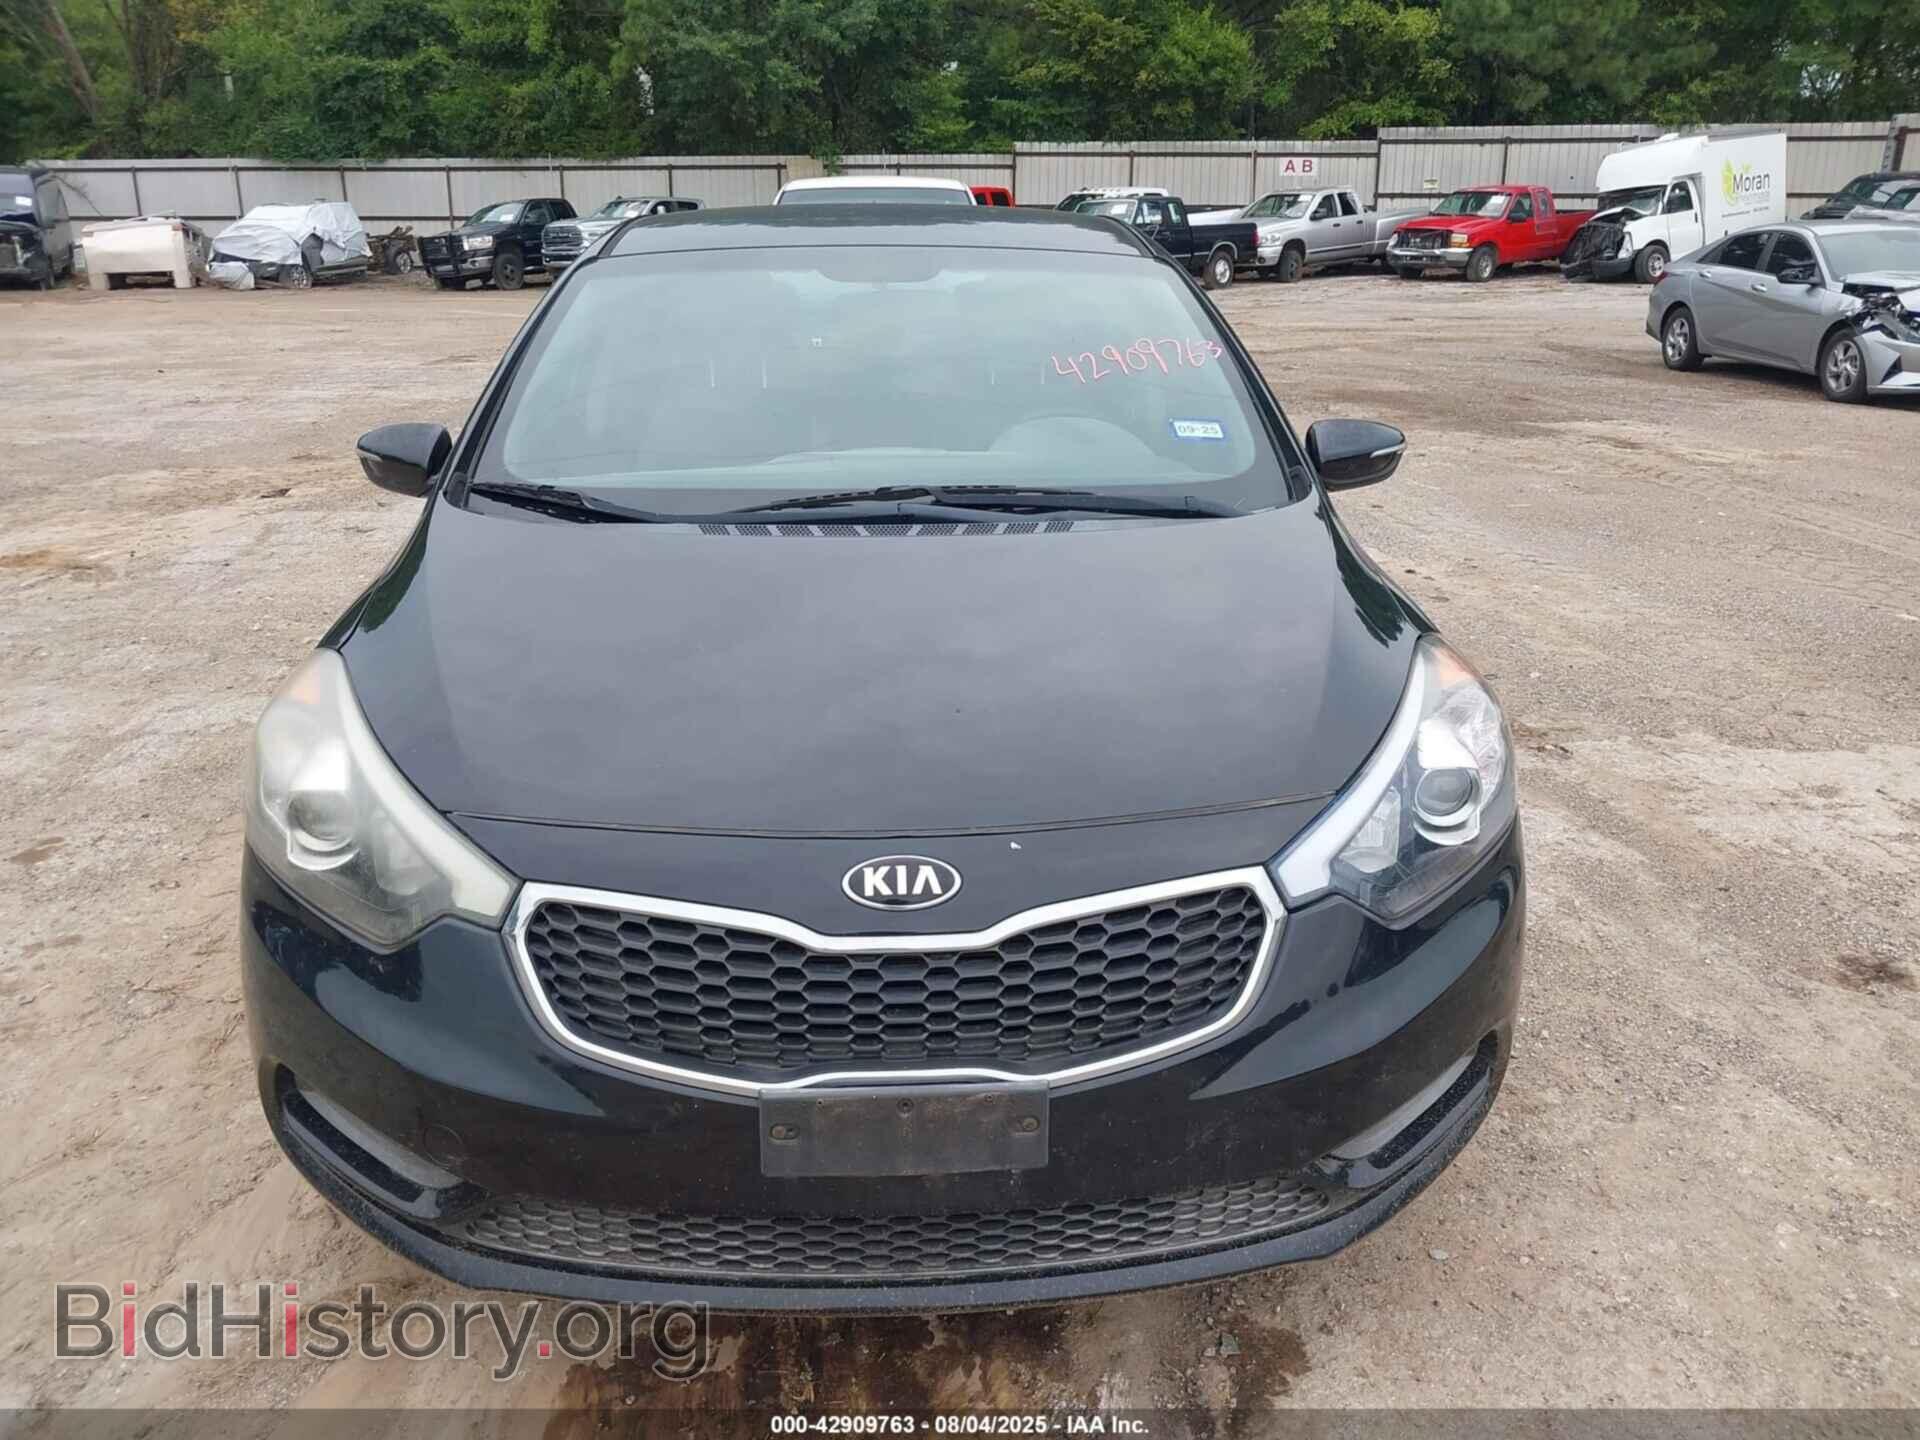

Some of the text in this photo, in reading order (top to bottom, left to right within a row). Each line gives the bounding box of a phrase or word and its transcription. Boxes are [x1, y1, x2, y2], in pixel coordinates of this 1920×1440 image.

[1733, 172, 1770, 193] Moran
[1051, 337, 1224, 384] 42909763
[862, 864, 943, 897] KIA
